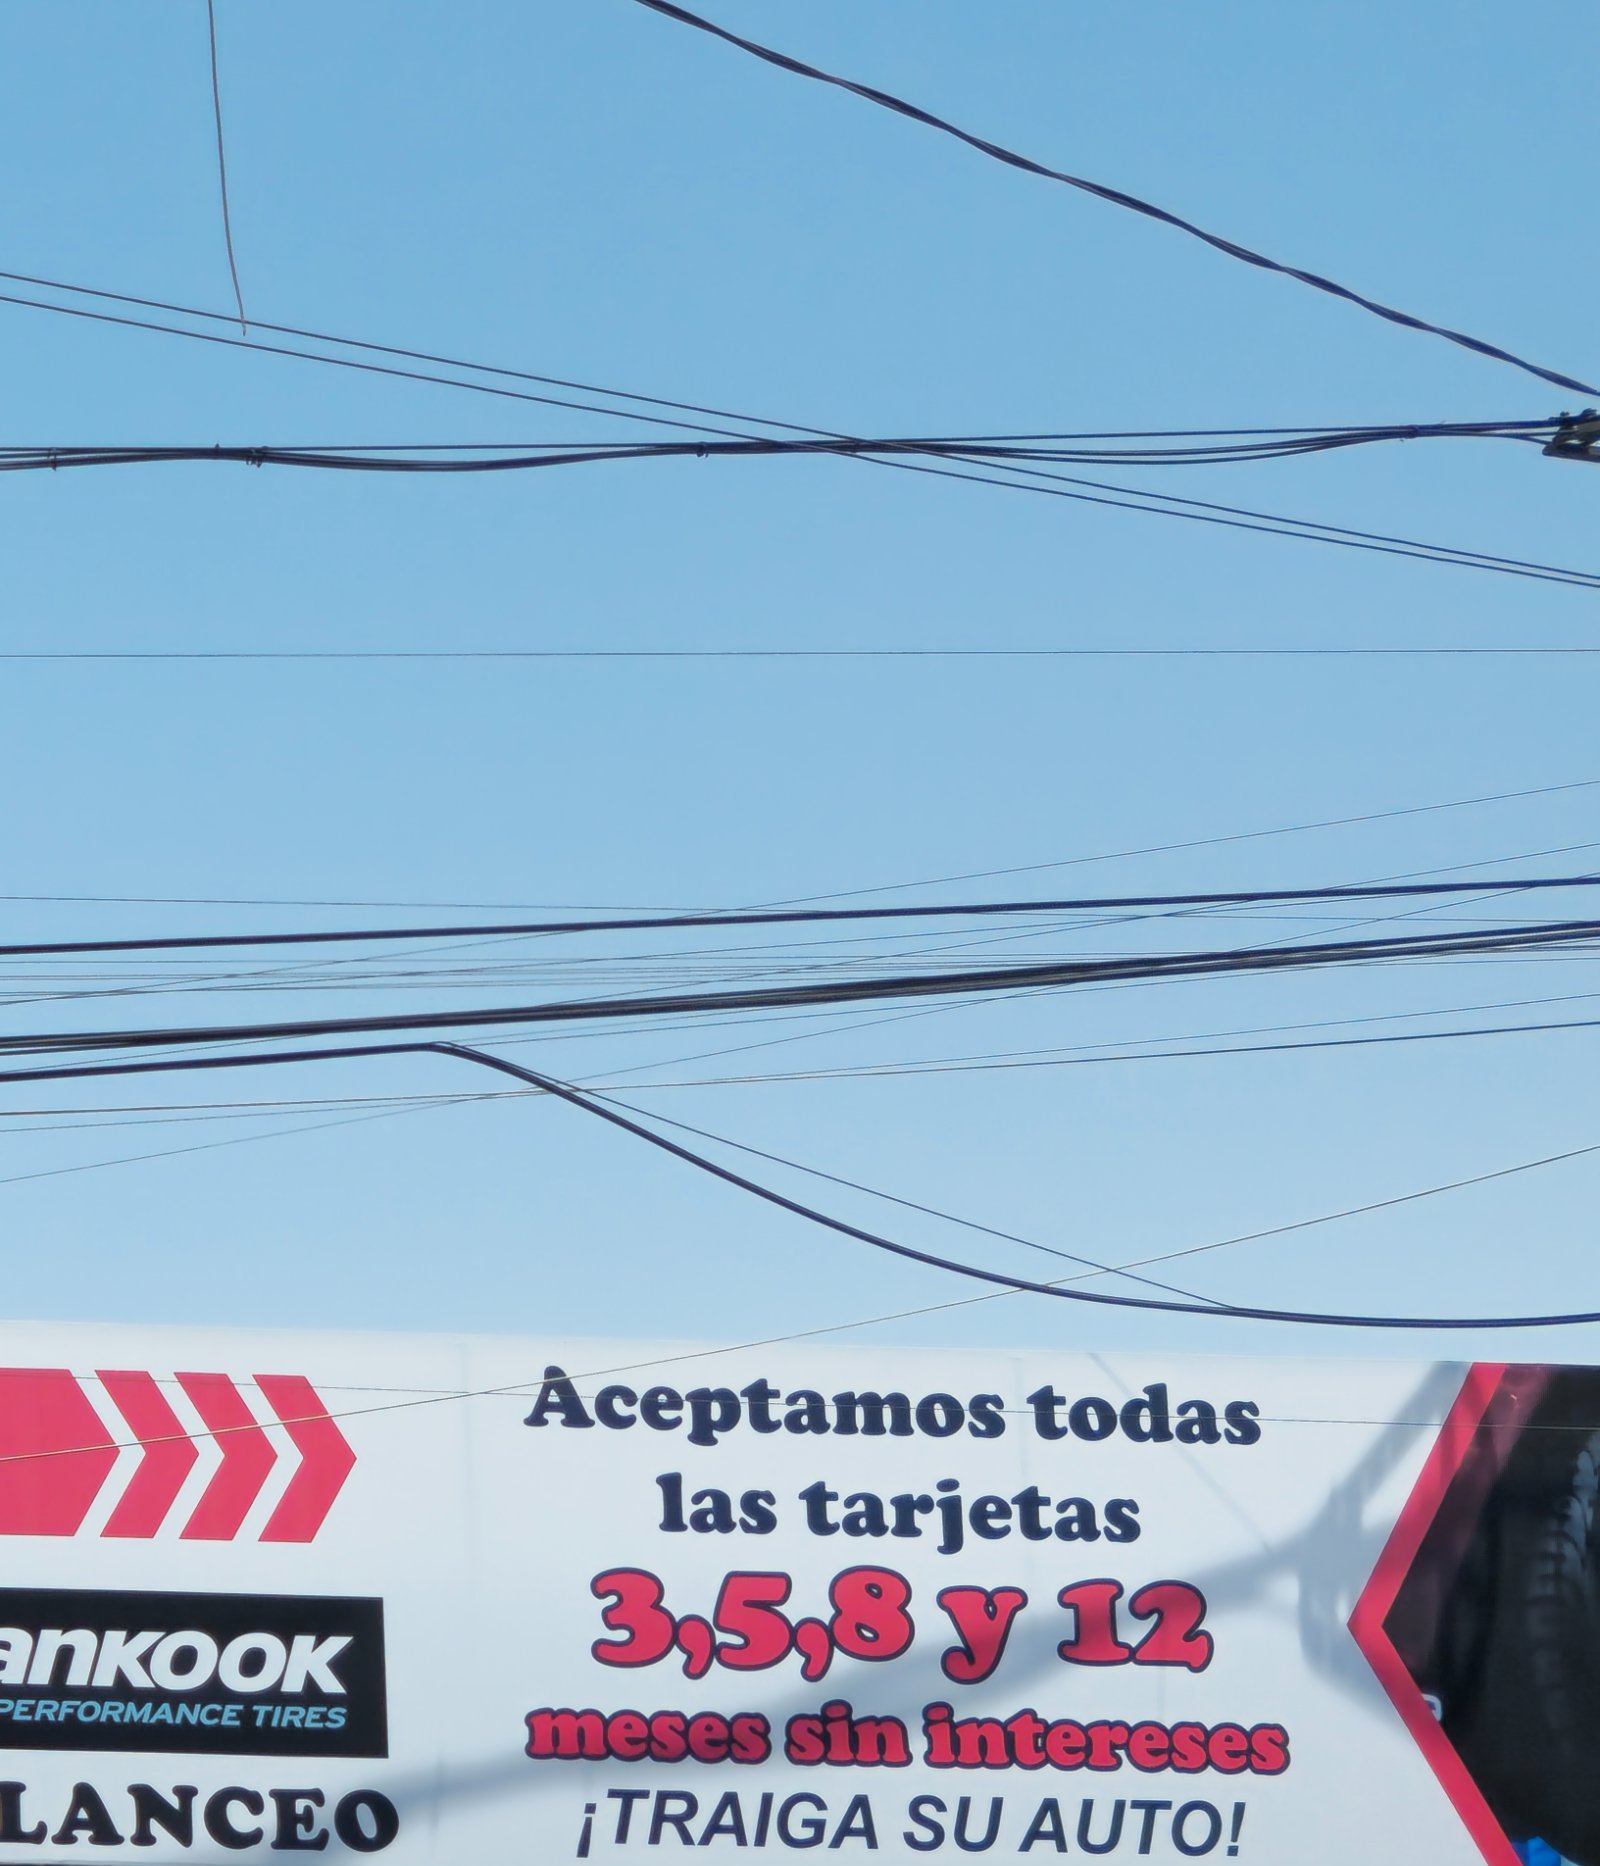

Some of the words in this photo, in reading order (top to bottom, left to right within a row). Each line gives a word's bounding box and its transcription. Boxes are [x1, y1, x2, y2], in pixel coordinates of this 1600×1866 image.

[524, 1366, 1005, 1446] Aceptamos
[1034, 1382, 1262, 1446] todas
[657, 1472, 778, 1535] las
[805, 1478, 1143, 1555] tarjetas
[590, 1565, 916, 1682] 3,5,8
[941, 1586, 1027, 1684] y
[1057, 1579, 1214, 1673] 12
[250, 1704, 348, 1730] TIRES
[524, 1703, 769, 1764] meses
[785, 1700, 914, 1768] sin
[925, 1702, 1291, 1775] intereses
[576, 1788, 876, 1860] ¡TRAIGA
[902, 1793, 1002, 1853] SU
[1020, 1796, 1248, 1858] AUTO!
